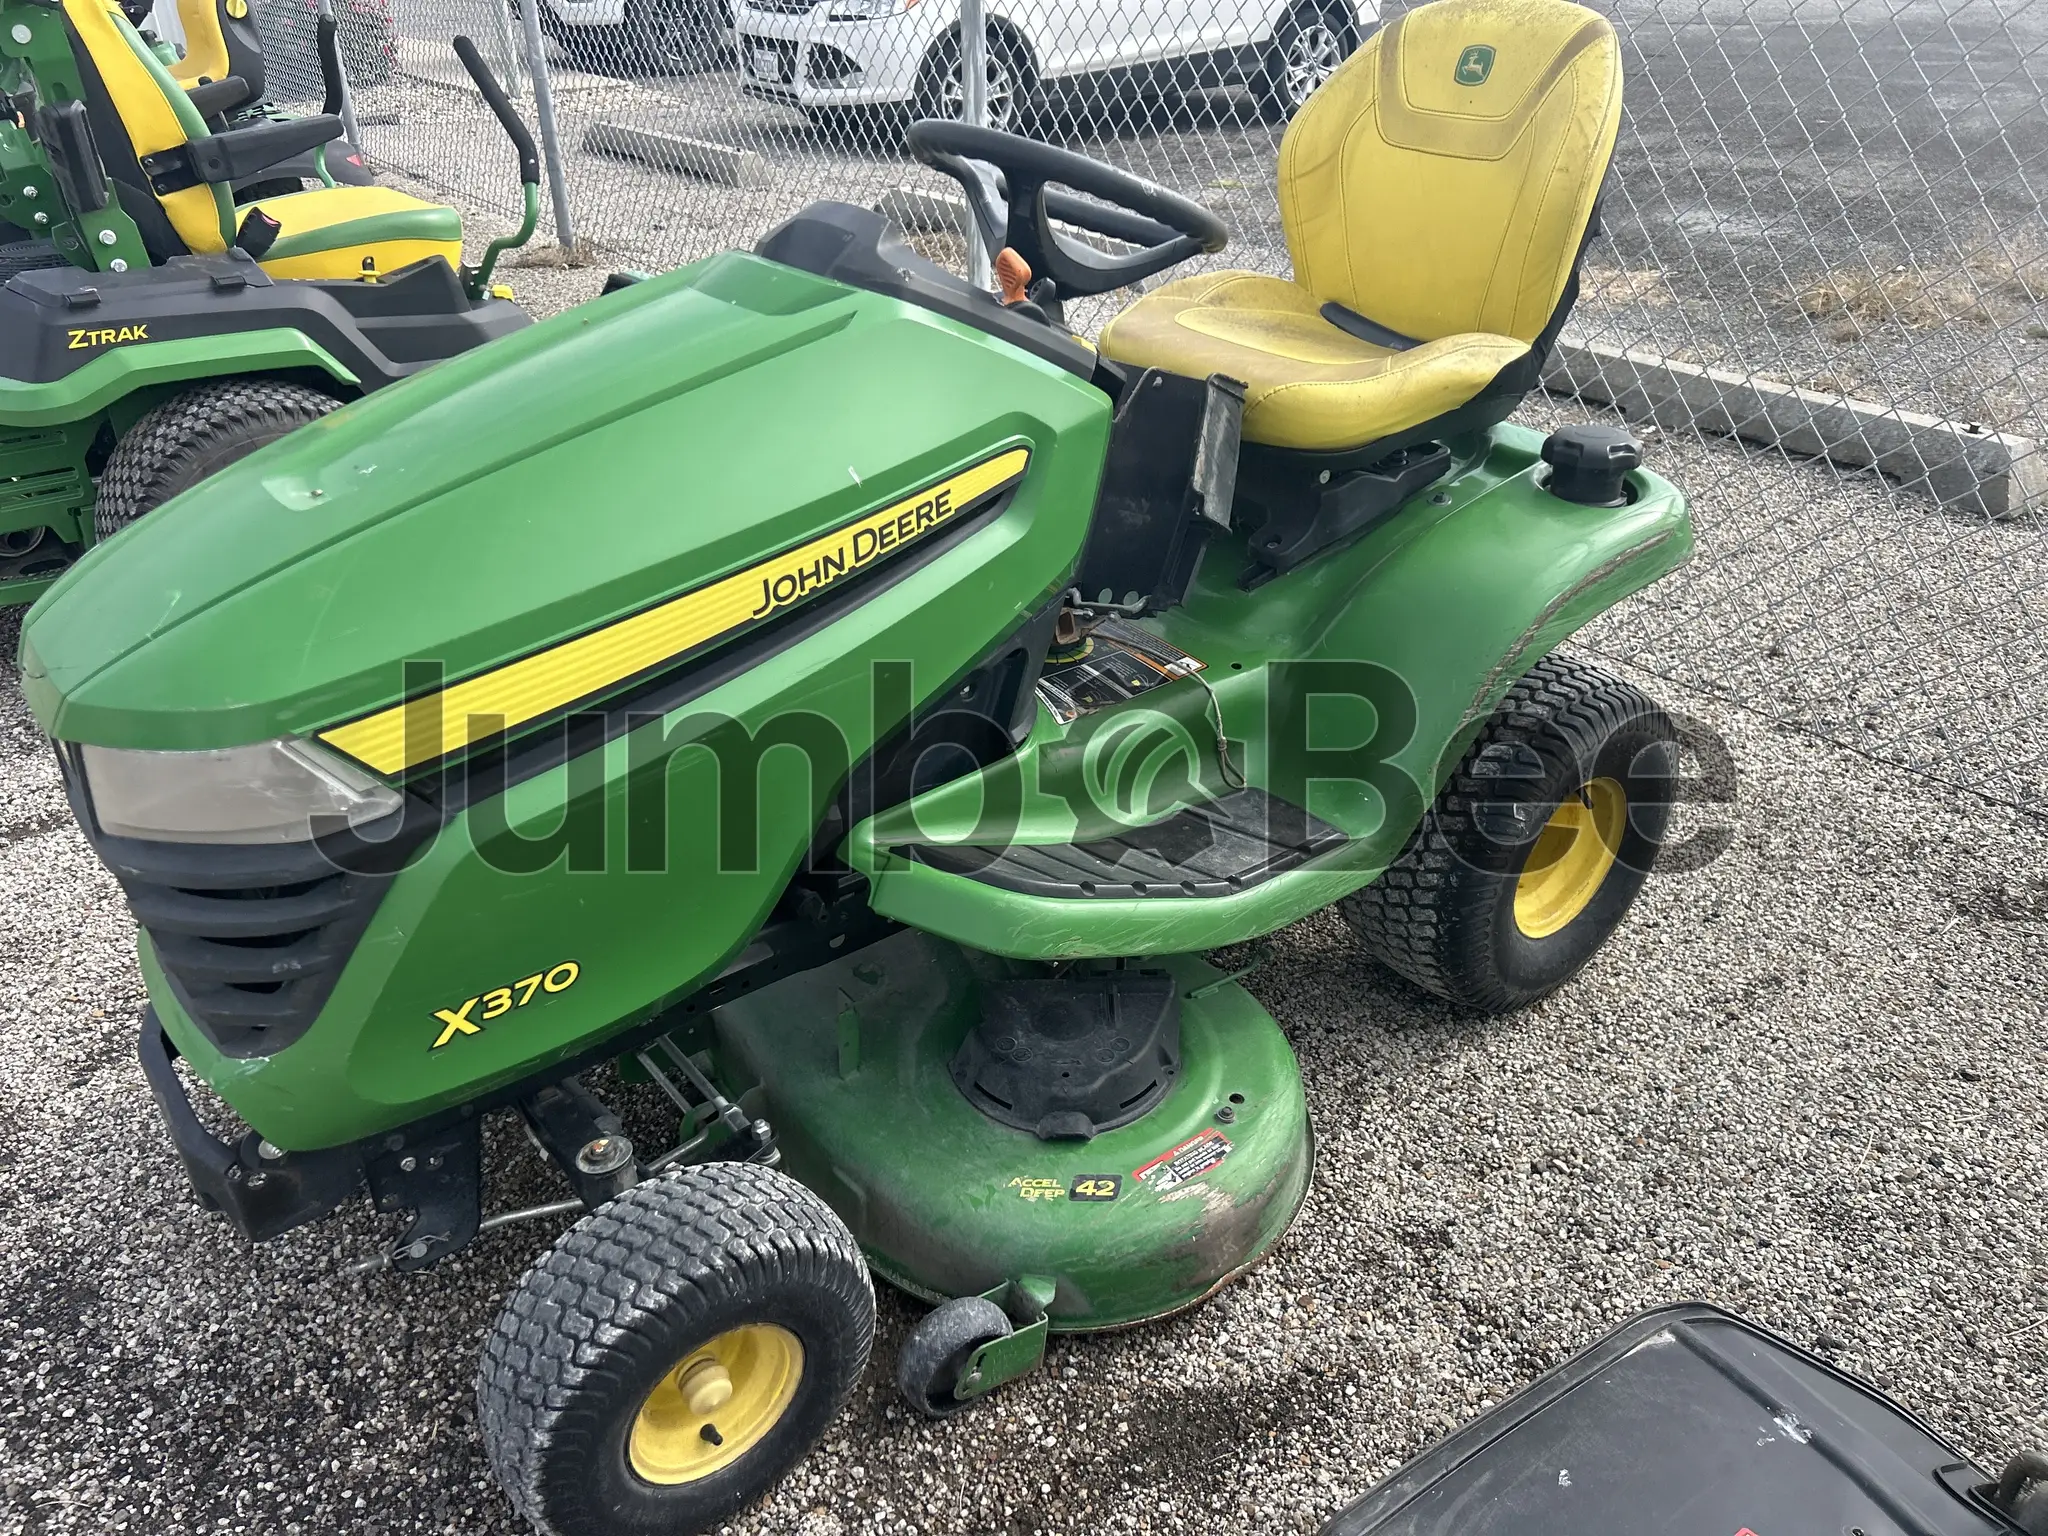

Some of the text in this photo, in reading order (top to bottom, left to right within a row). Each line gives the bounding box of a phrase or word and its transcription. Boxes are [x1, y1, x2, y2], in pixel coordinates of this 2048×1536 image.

[67, 324, 149, 349] ZTRAK
[752, 488, 952, 617] JOHN DEERE
[430, 961, 580, 1050] X370
[1007, 1177, 1061, 1187] ACCEL
[1075, 1180, 1116, 1196] 42
